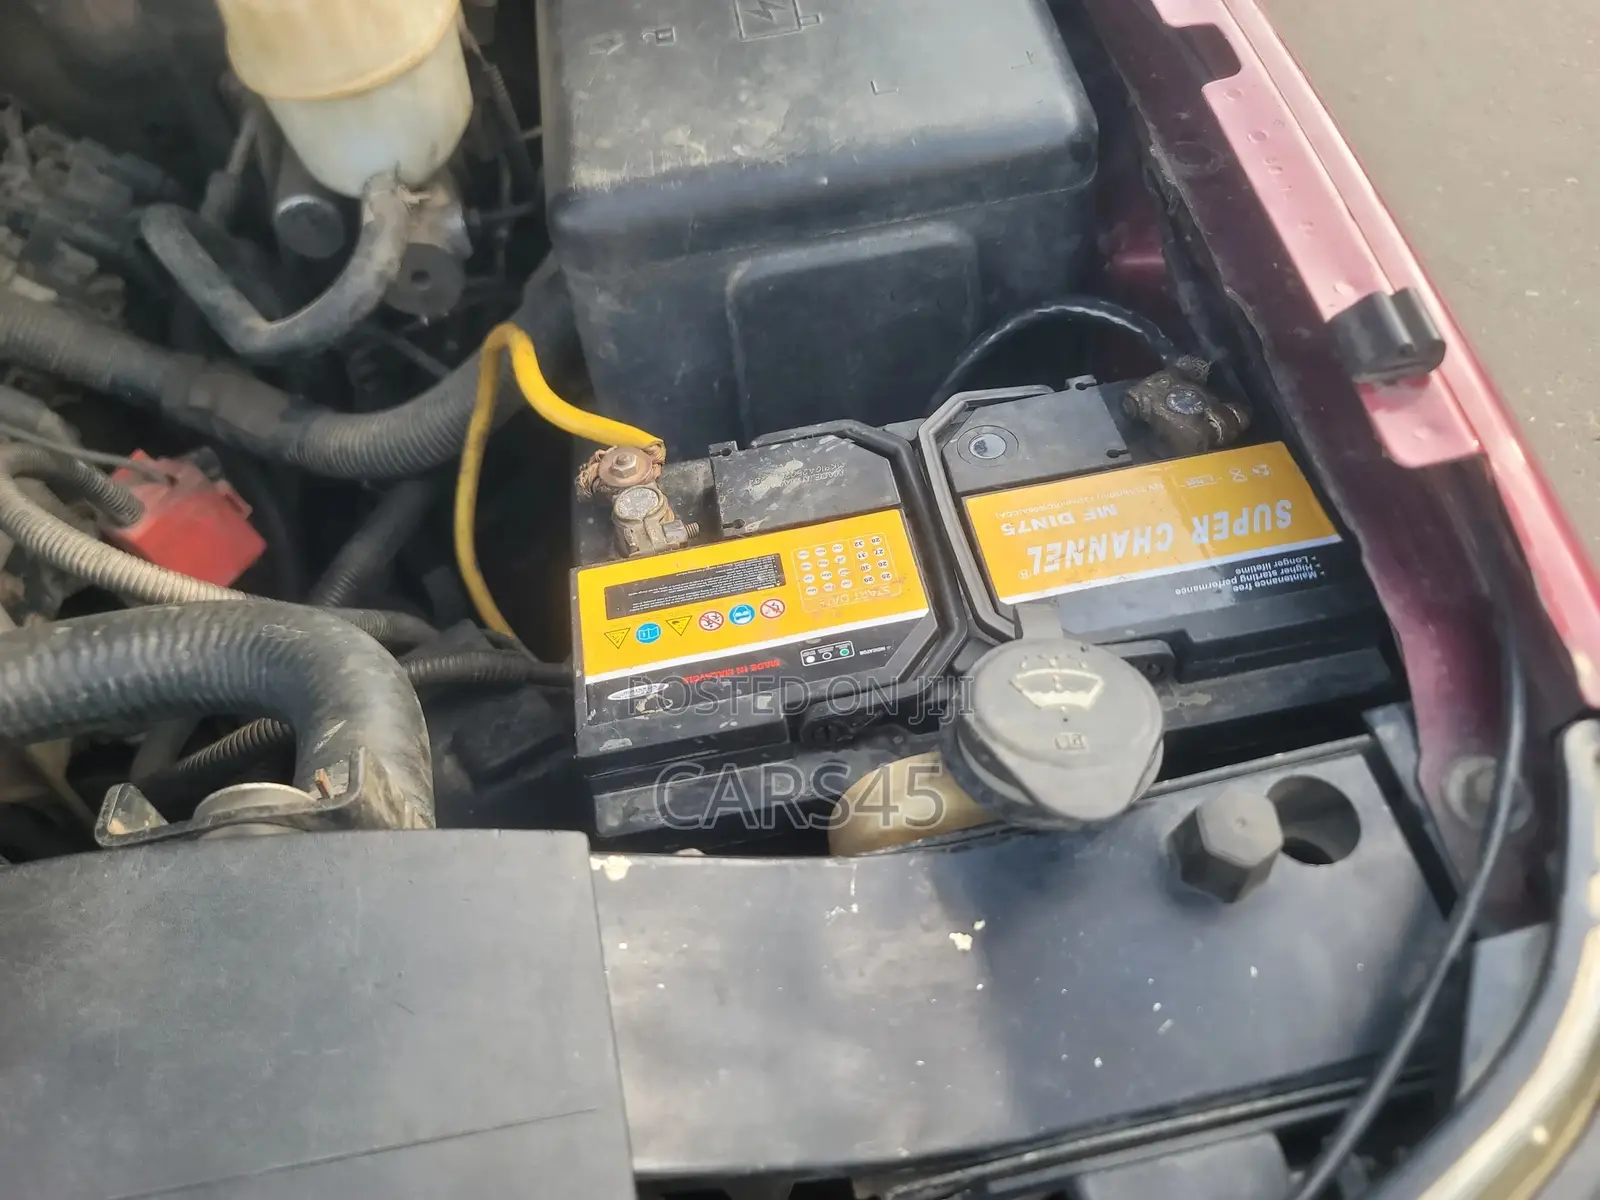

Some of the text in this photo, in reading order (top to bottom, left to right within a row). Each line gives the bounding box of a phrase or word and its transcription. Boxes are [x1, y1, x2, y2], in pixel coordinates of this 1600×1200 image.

[1000, 504, 1118, 536] MF DIN75
[1027, 499, 1292, 575] SUPER CHANNEL
[1235, 556, 1309, 575] Longer lifetime
[1175, 562, 1313, 595] Higher starting performance
[1232, 571, 1318, 593] Maintenance free
[736, 664, 750, 675] IN
[751, 658, 782, 672] MADE
